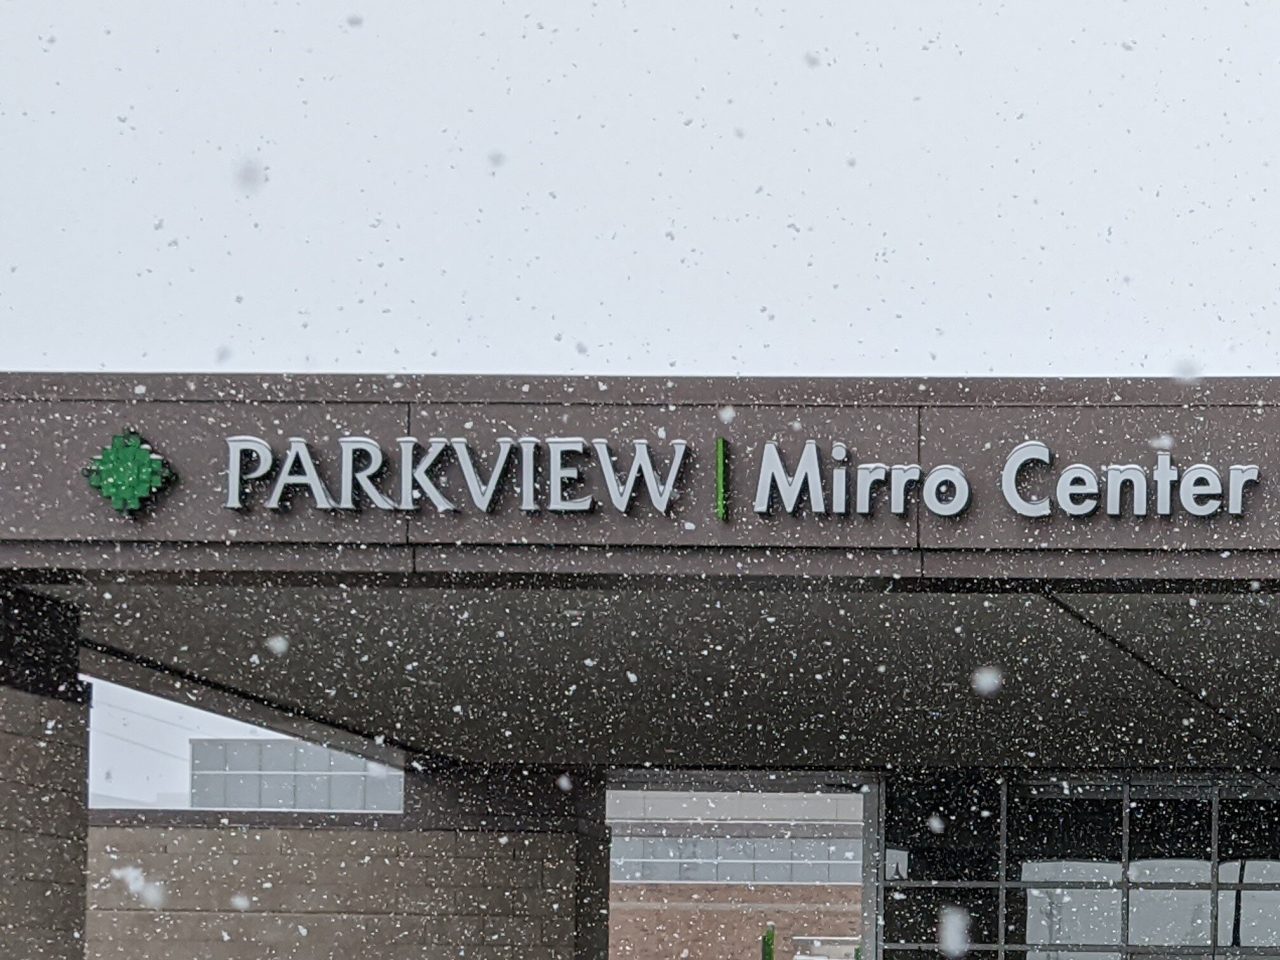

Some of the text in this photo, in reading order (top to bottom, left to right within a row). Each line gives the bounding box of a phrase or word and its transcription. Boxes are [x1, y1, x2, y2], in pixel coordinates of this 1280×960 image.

[223, 435, 688, 513] PARKVIEW
[753, 440, 971, 517] Mirro
[1001, 440, 1259, 518] Center
